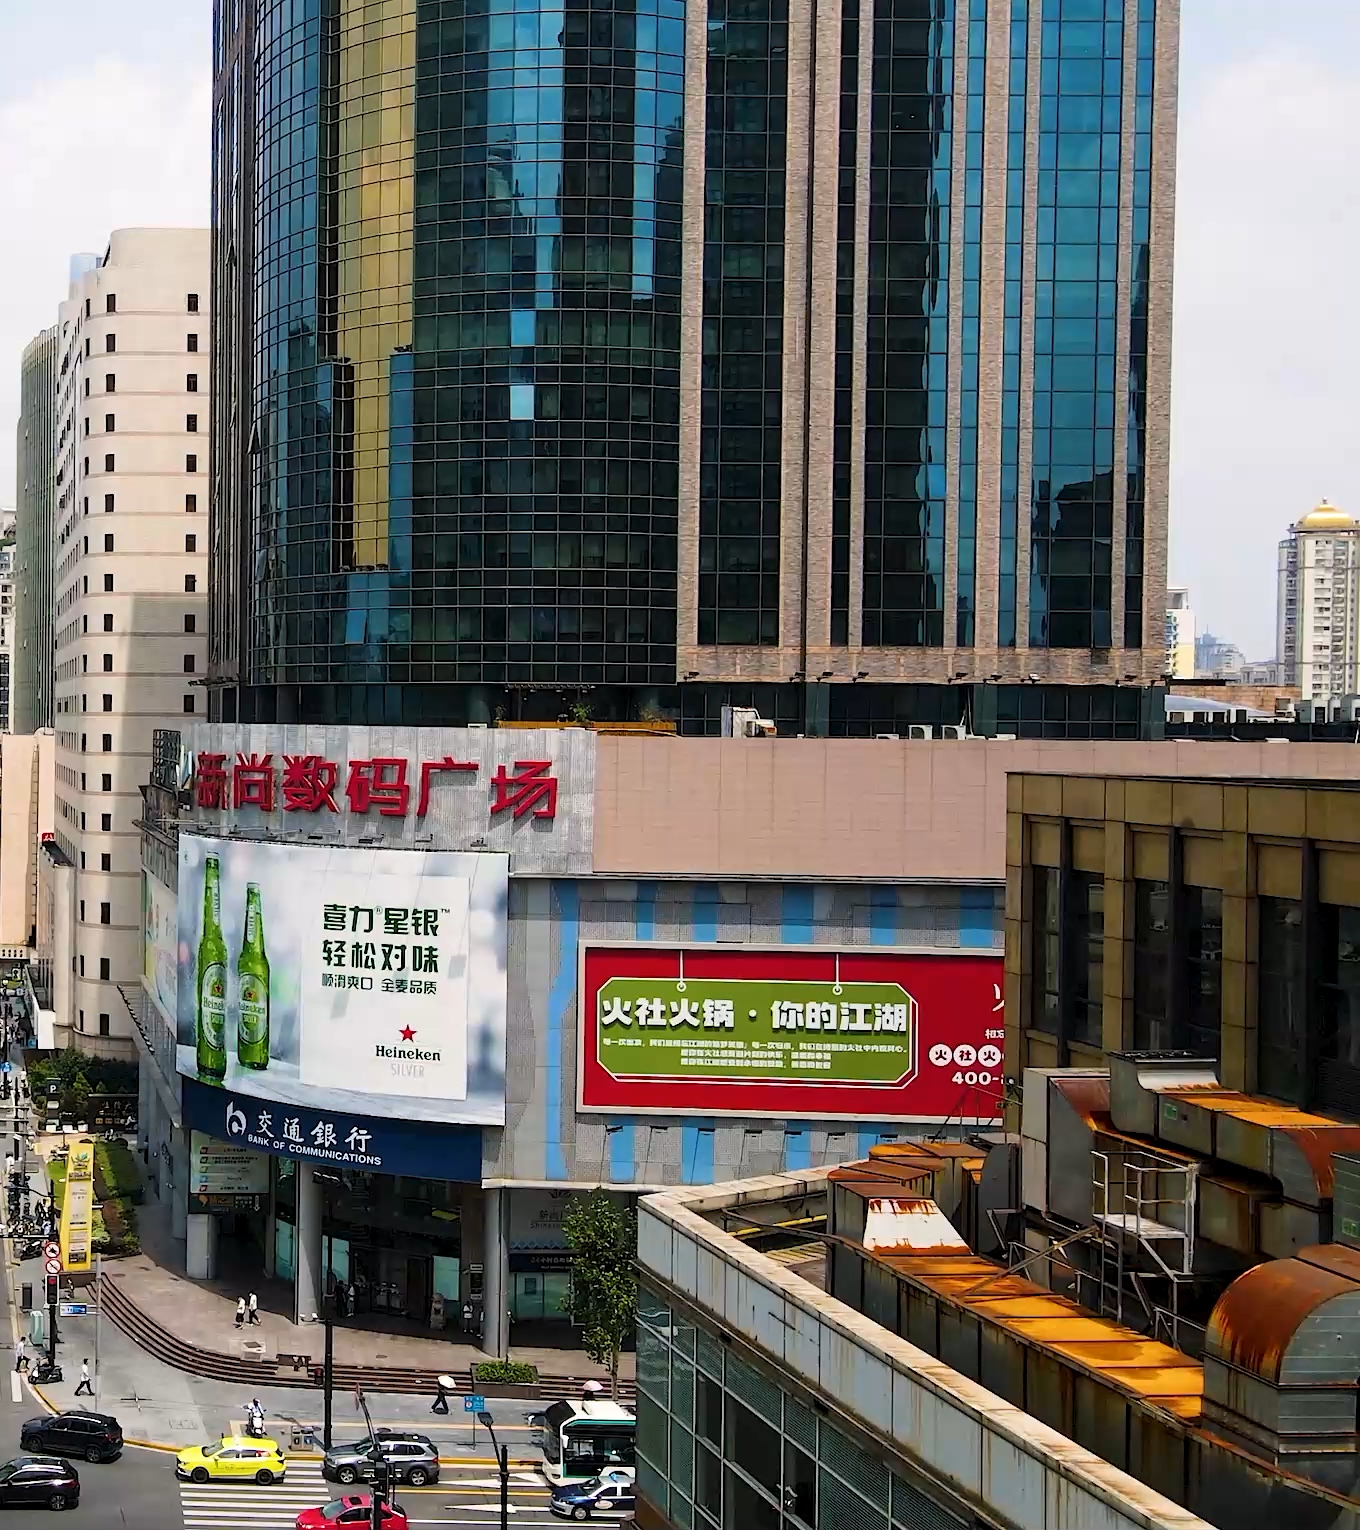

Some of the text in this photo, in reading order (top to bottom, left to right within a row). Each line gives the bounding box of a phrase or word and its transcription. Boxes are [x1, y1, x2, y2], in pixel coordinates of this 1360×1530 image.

[196, 750, 558, 820] 新尚数码广场
[322, 940, 439, 973] 轻松对味
[375, 1045, 441, 1061] Heineken
[391, 1063, 425, 1078] SILVER
[255, 1110, 373, 1152] 交通銀行
[247, 1133, 382, 1167] BANK OF COMMUNICATIONS
